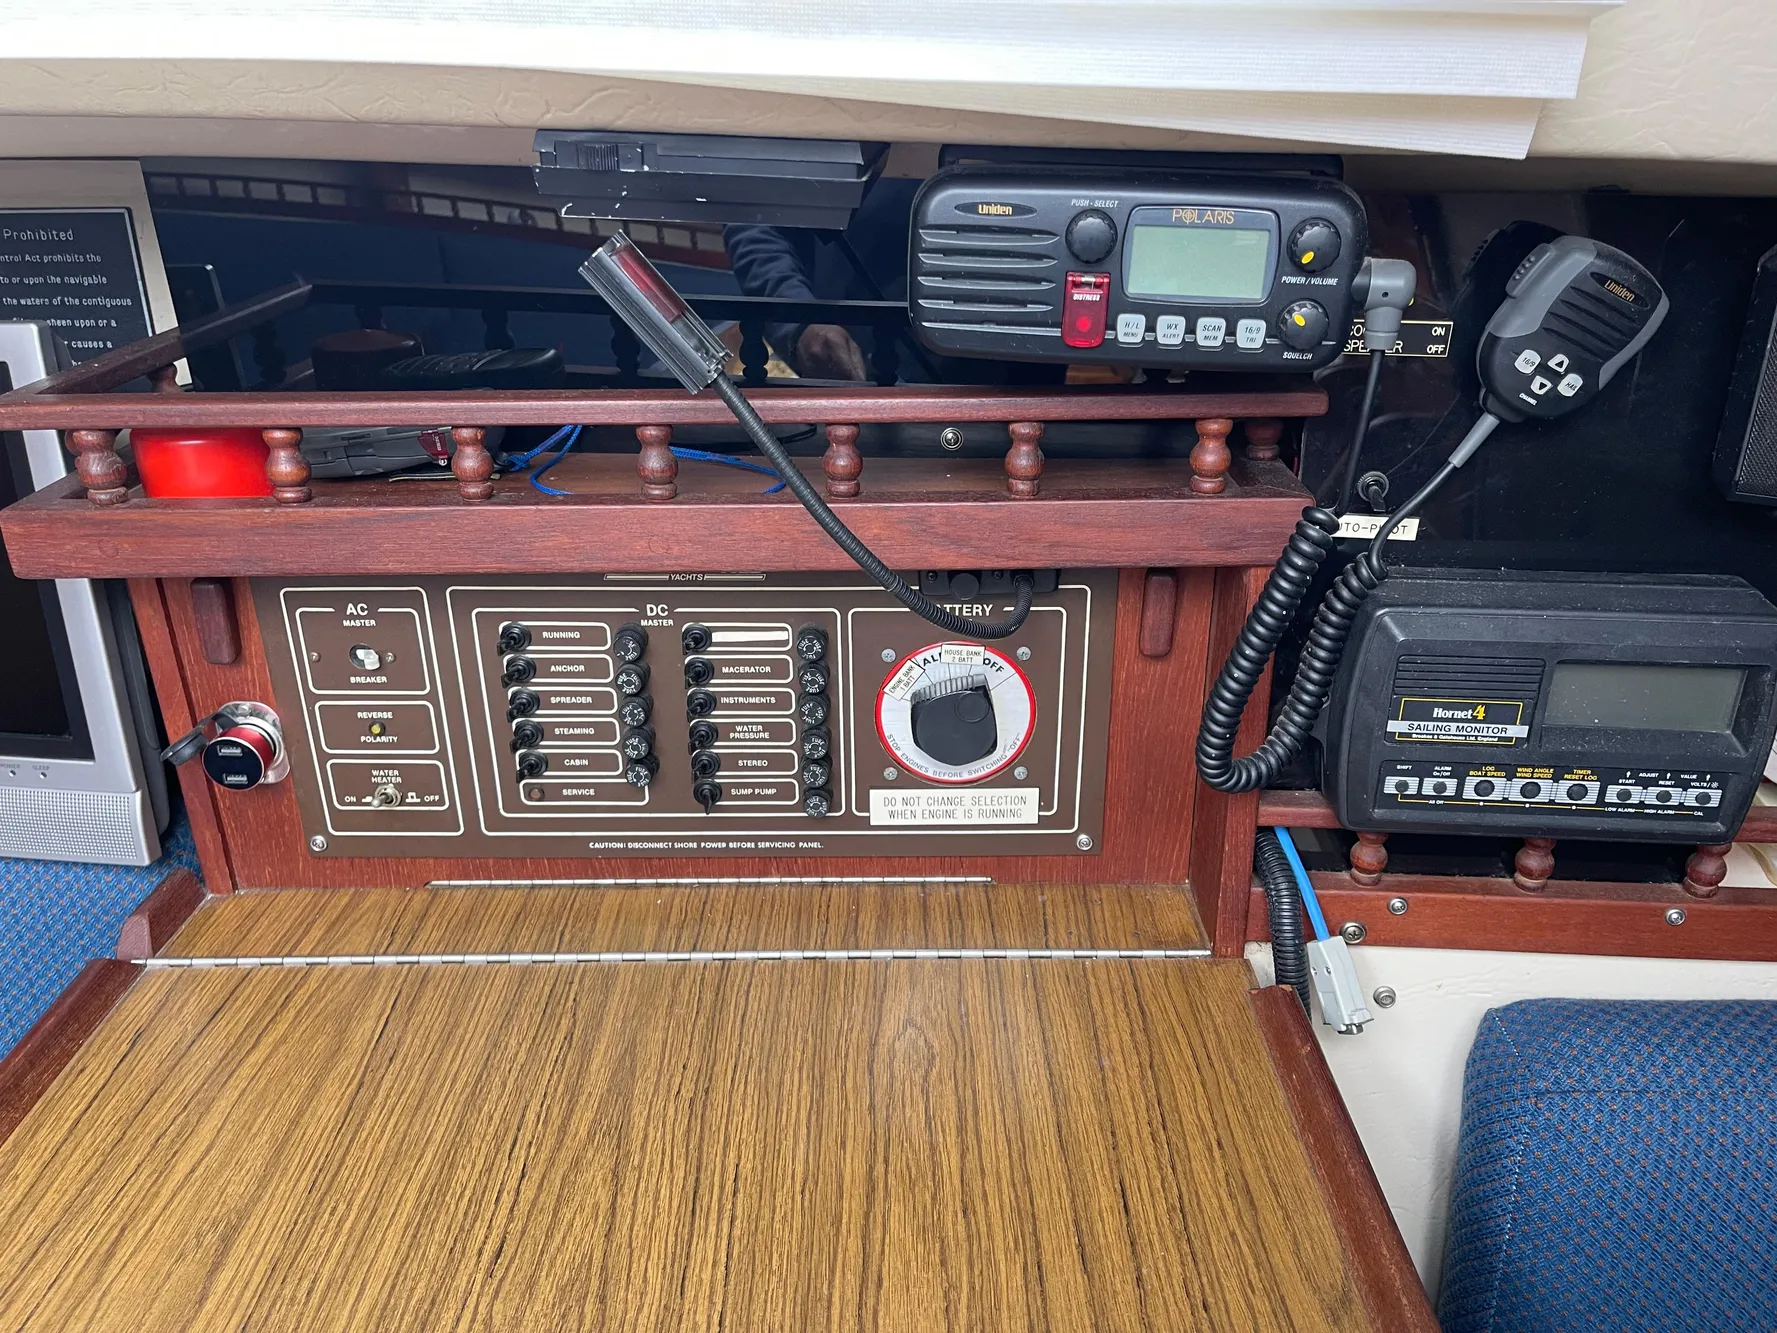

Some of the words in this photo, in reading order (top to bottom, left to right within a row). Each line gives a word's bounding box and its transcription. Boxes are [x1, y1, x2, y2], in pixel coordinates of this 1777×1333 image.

[978, 204, 1012, 215] Uniden
[1172, 209, 1235, 224] POLARIS
[3, 228, 74, 241] Prohibited
[25, 254, 41, 262] Act
[43, 253, 84, 263] prohibits
[86, 254, 102, 262] the
[23, 277, 45, 285] upon
[47, 275, 61, 284] the
[64, 275, 107, 286] navigable
[1604, 279, 1635, 302] Uniden
[3, 297, 17, 305] the
[20, 297, 49, 306] waters
[52, 297, 61, 306] of
[64, 297, 80, 306] the
[82, 297, 132, 308] contiguous
[74, 320, 96, 328] upon
[1431, 327, 1446, 336] ON
[1343, 340, 1404, 353] SPER
[1426, 345, 1446, 354] OFF
[1282, 351, 1313, 359] SQUELCH
[1522, 357, 1536, 367] 16/9
[670, 573, 703, 581] YACHTS
[346, 603, 368, 616] AC
[646, 604, 669, 616] DC
[342, 619, 376, 627] MASTER
[641, 619, 674, 627] MASTER
[542, 631, 580, 639] RUNNING
[983, 658, 1005, 673] OFF
[889, 677, 905, 694] ENGINE
[904, 665, 916, 679] BANK
[904, 675, 916, 689] BATT
[550, 696, 593, 704] SPREADER
[1432, 707, 1472, 719] Hornet
[1472, 704, 1486, 720] 4
[554, 727, 595, 735] STEAMING
[1407, 723, 1451, 732] SAILING
[1455, 725, 1508, 735] MONITOR
[887, 734, 901, 752] STOP
[901, 752, 929, 773] ENGINES
[932, 770, 964, 778] BEFORE
[968, 753, 1008, 775] SWITCHING
[883, 796, 897, 807] DO
[902, 796, 921, 806] NOT
[926, 796, 965, 806] CHANGE
[971, 795, 1027, 806] SELECTION
[888, 810, 916, 820] WHEN
[922, 809, 958, 820] ENGINE
[963, 809, 973, 819] IS
[978, 809, 1022, 819] RUNNING
